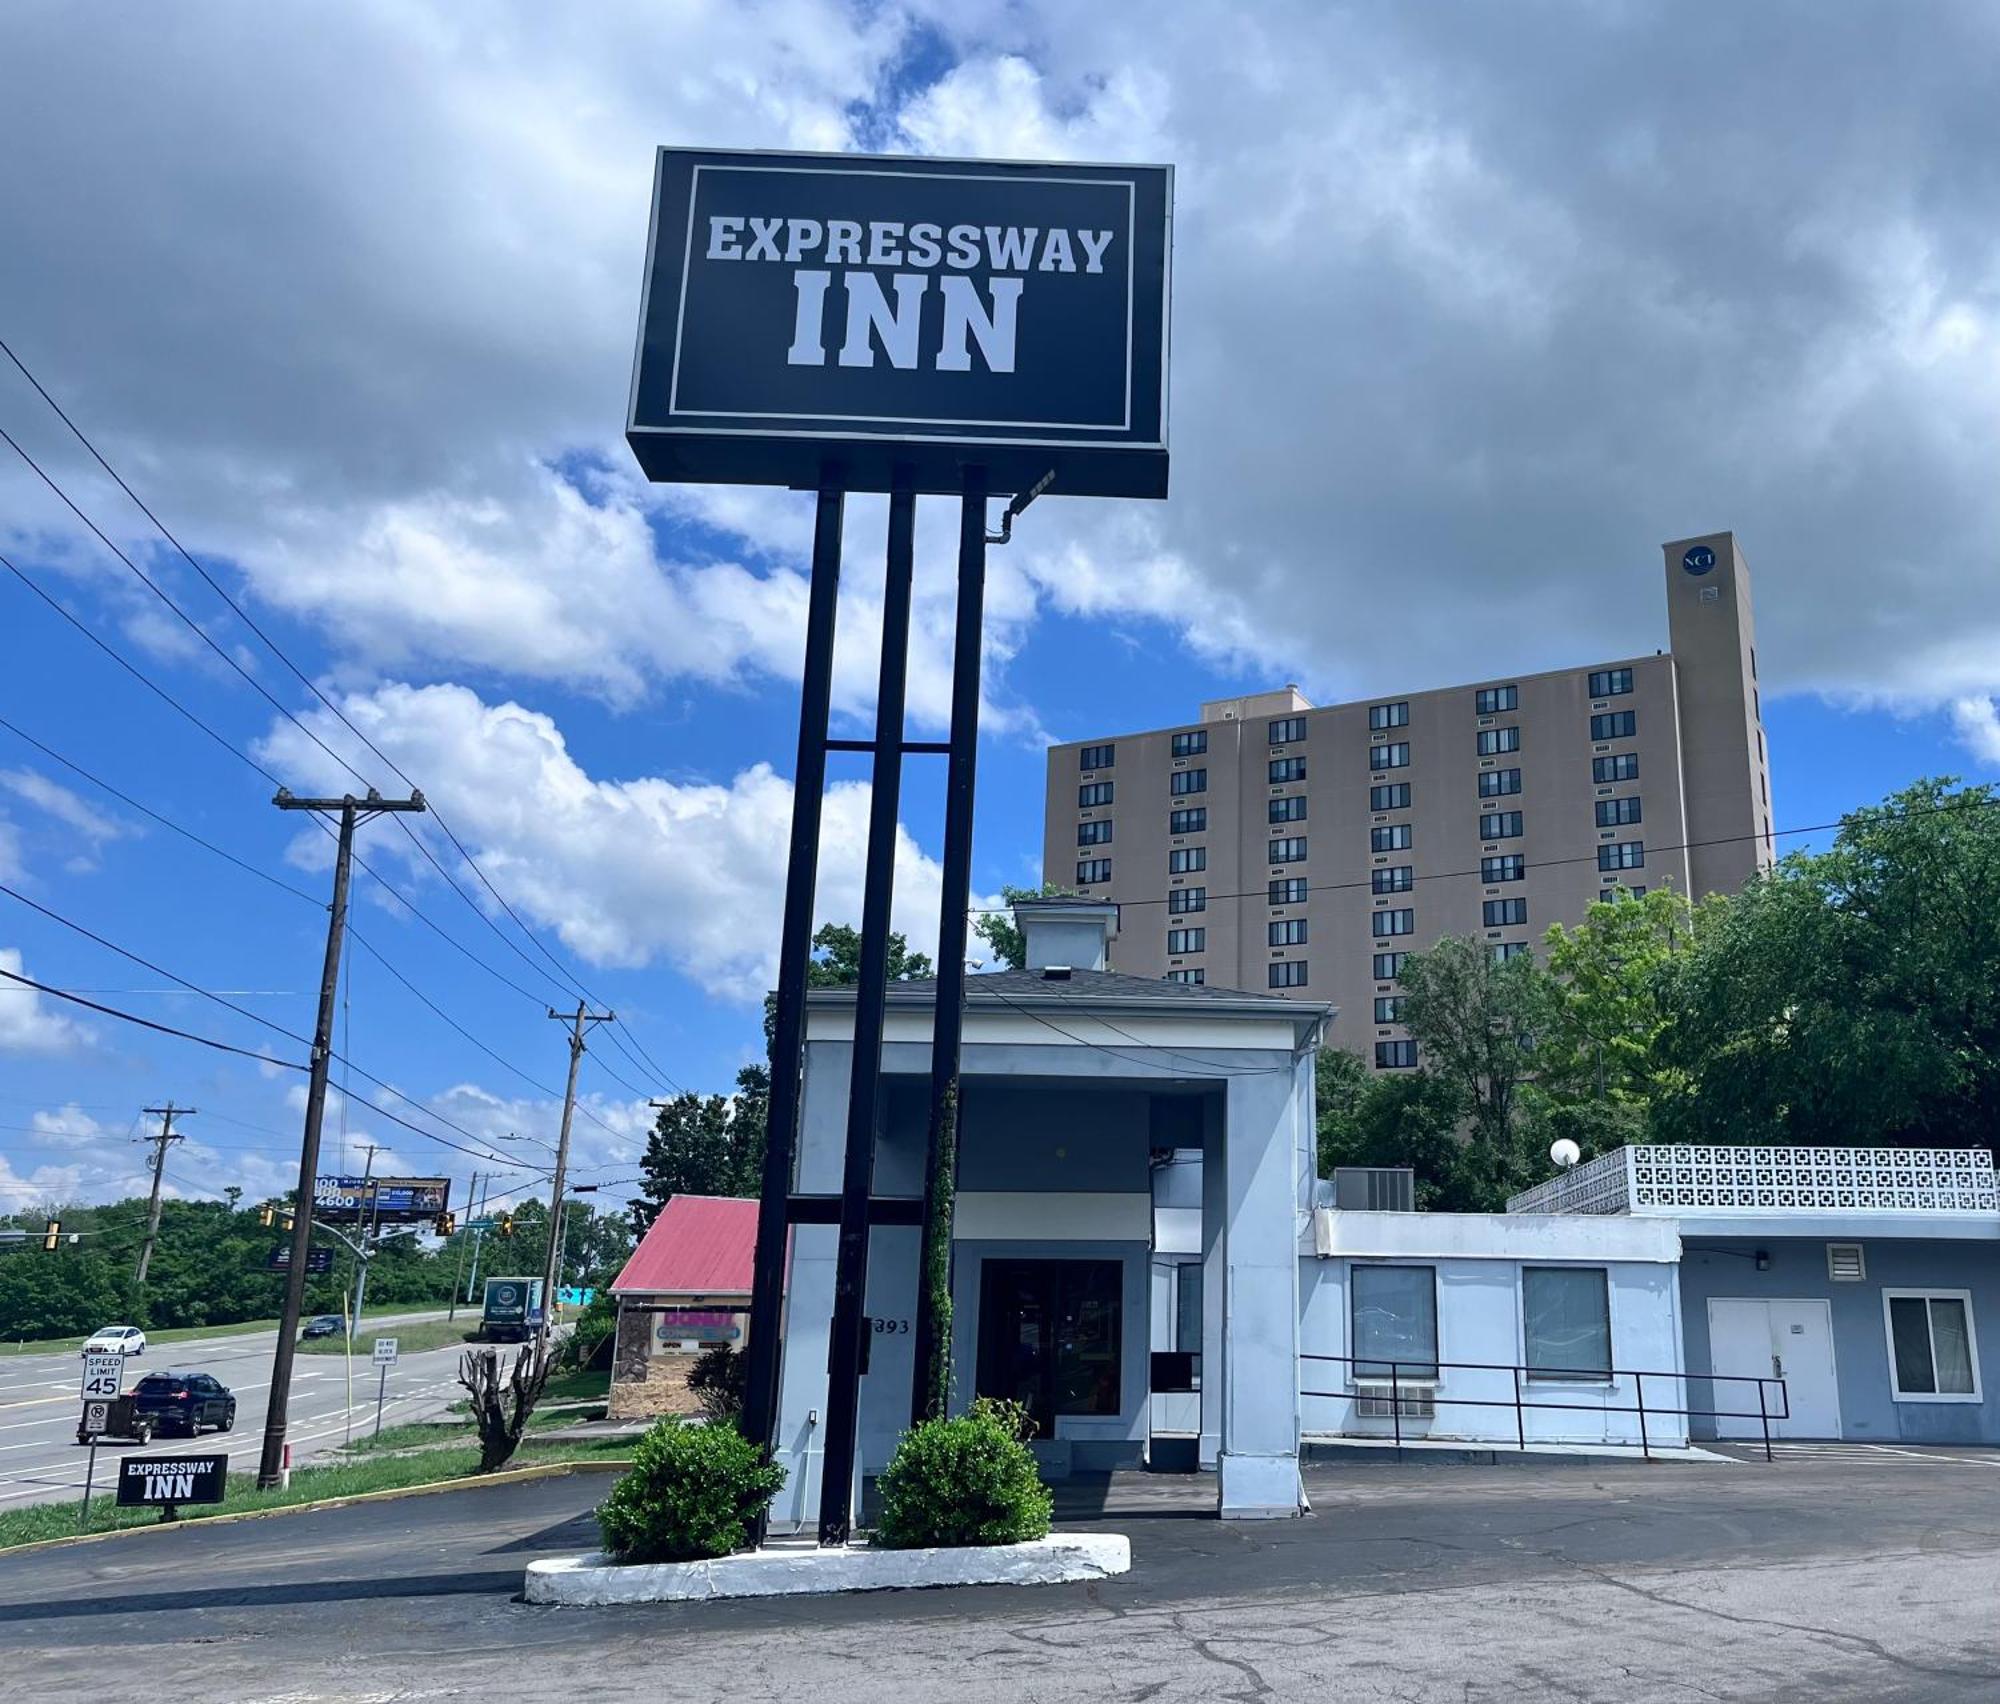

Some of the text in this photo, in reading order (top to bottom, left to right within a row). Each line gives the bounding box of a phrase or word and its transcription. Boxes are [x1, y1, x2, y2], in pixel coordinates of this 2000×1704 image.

[705, 215, 1114, 275] EXPRESSWAY
[787, 269, 1024, 373] INN
[316, 1195, 354, 1207] 4600
[88, 1358, 120, 1366] SPEED
[90, 1367, 116, 1375] LIMIT
[86, 1377, 117, 1395] 45
[127, 1461, 214, 1476] EXPRESSWAY
[143, 1474, 195, 1500] INN
